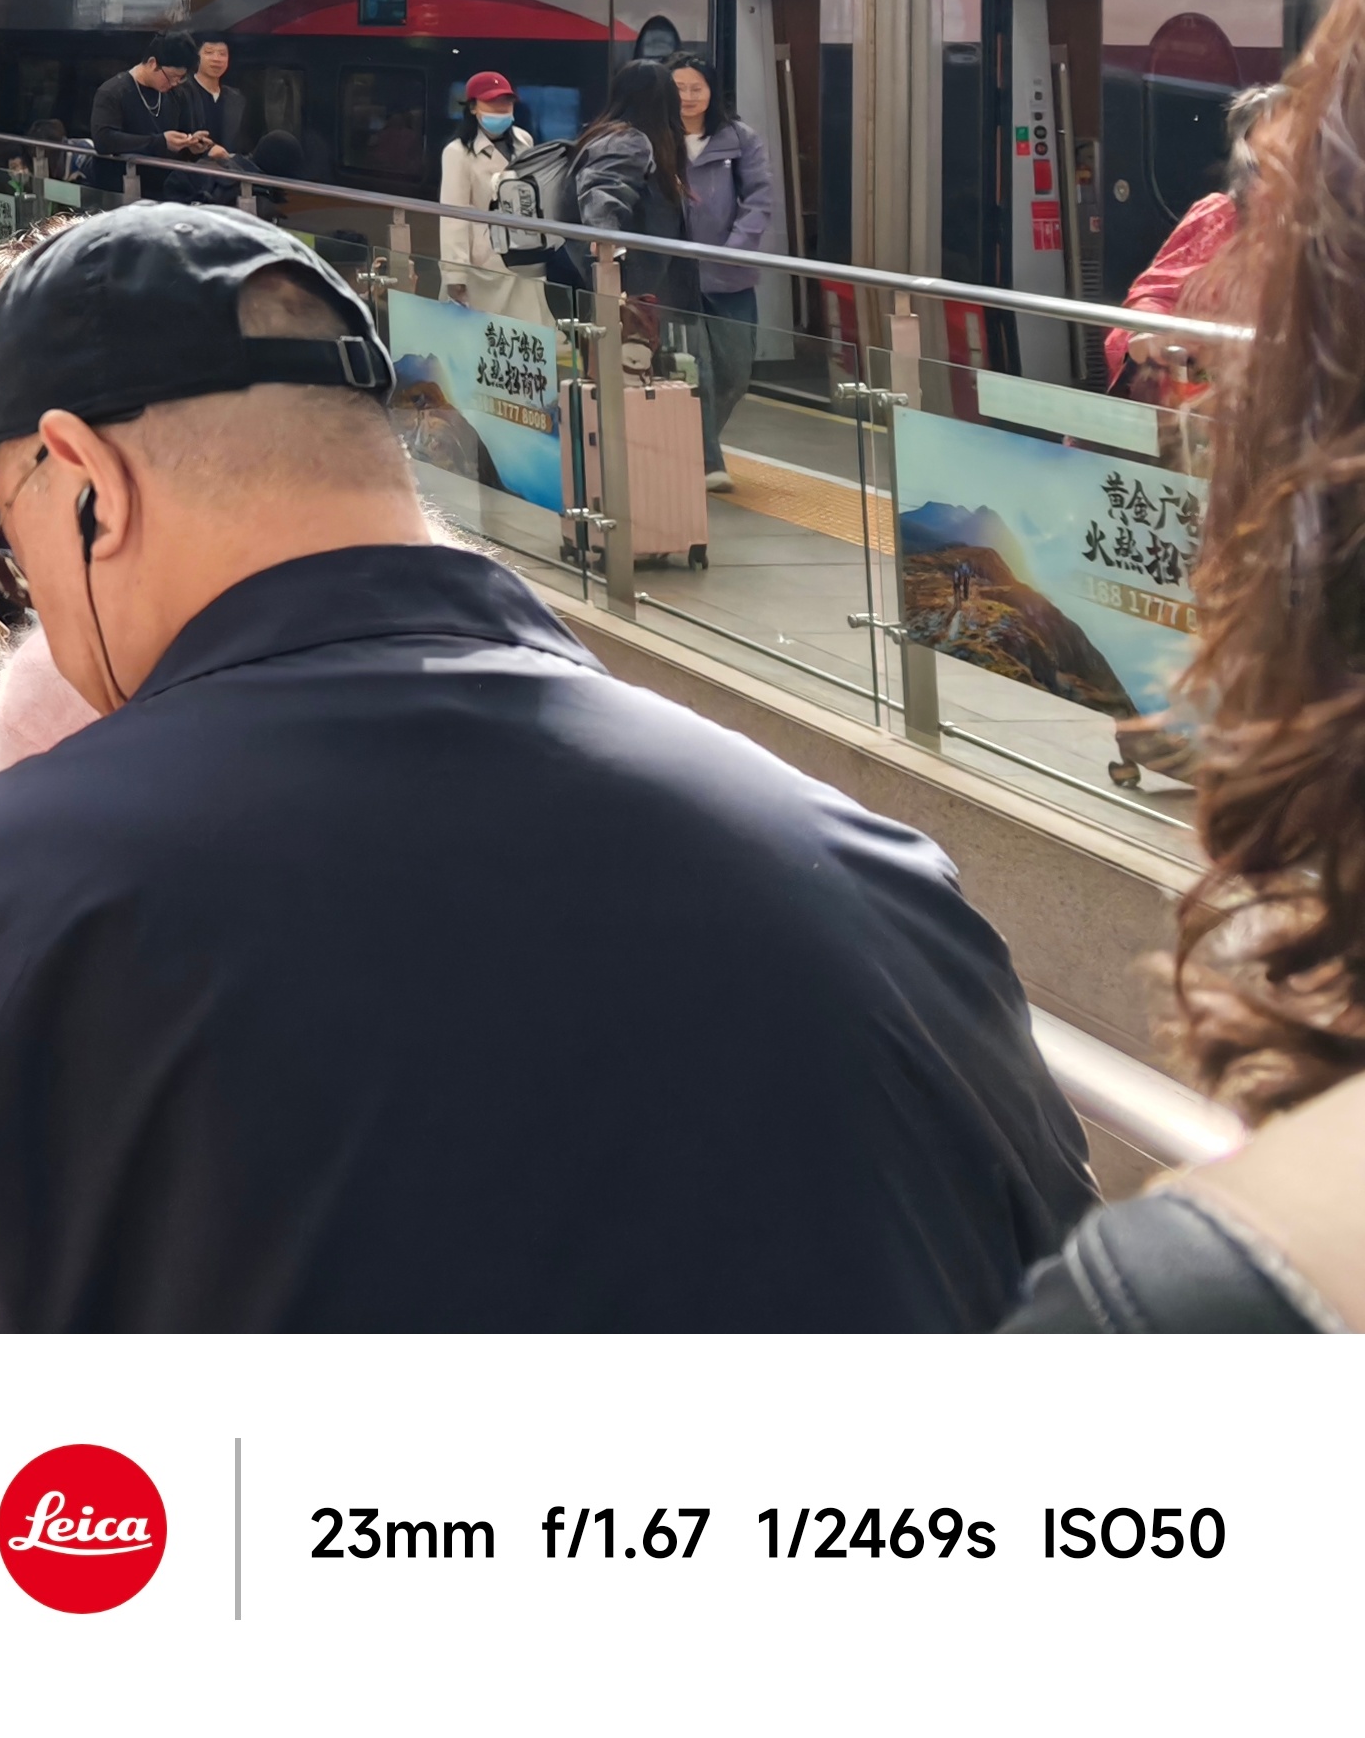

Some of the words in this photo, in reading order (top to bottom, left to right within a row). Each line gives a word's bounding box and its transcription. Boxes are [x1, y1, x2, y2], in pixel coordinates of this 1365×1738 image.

[484, 321, 547, 365] 黄金广告位
[476, 356, 548, 407] 火热招商中
[1100, 470, 1201, 538] 黄金广告
[1081, 519, 1200, 586] 火热招
[1129, 590, 1179, 626] 1777
